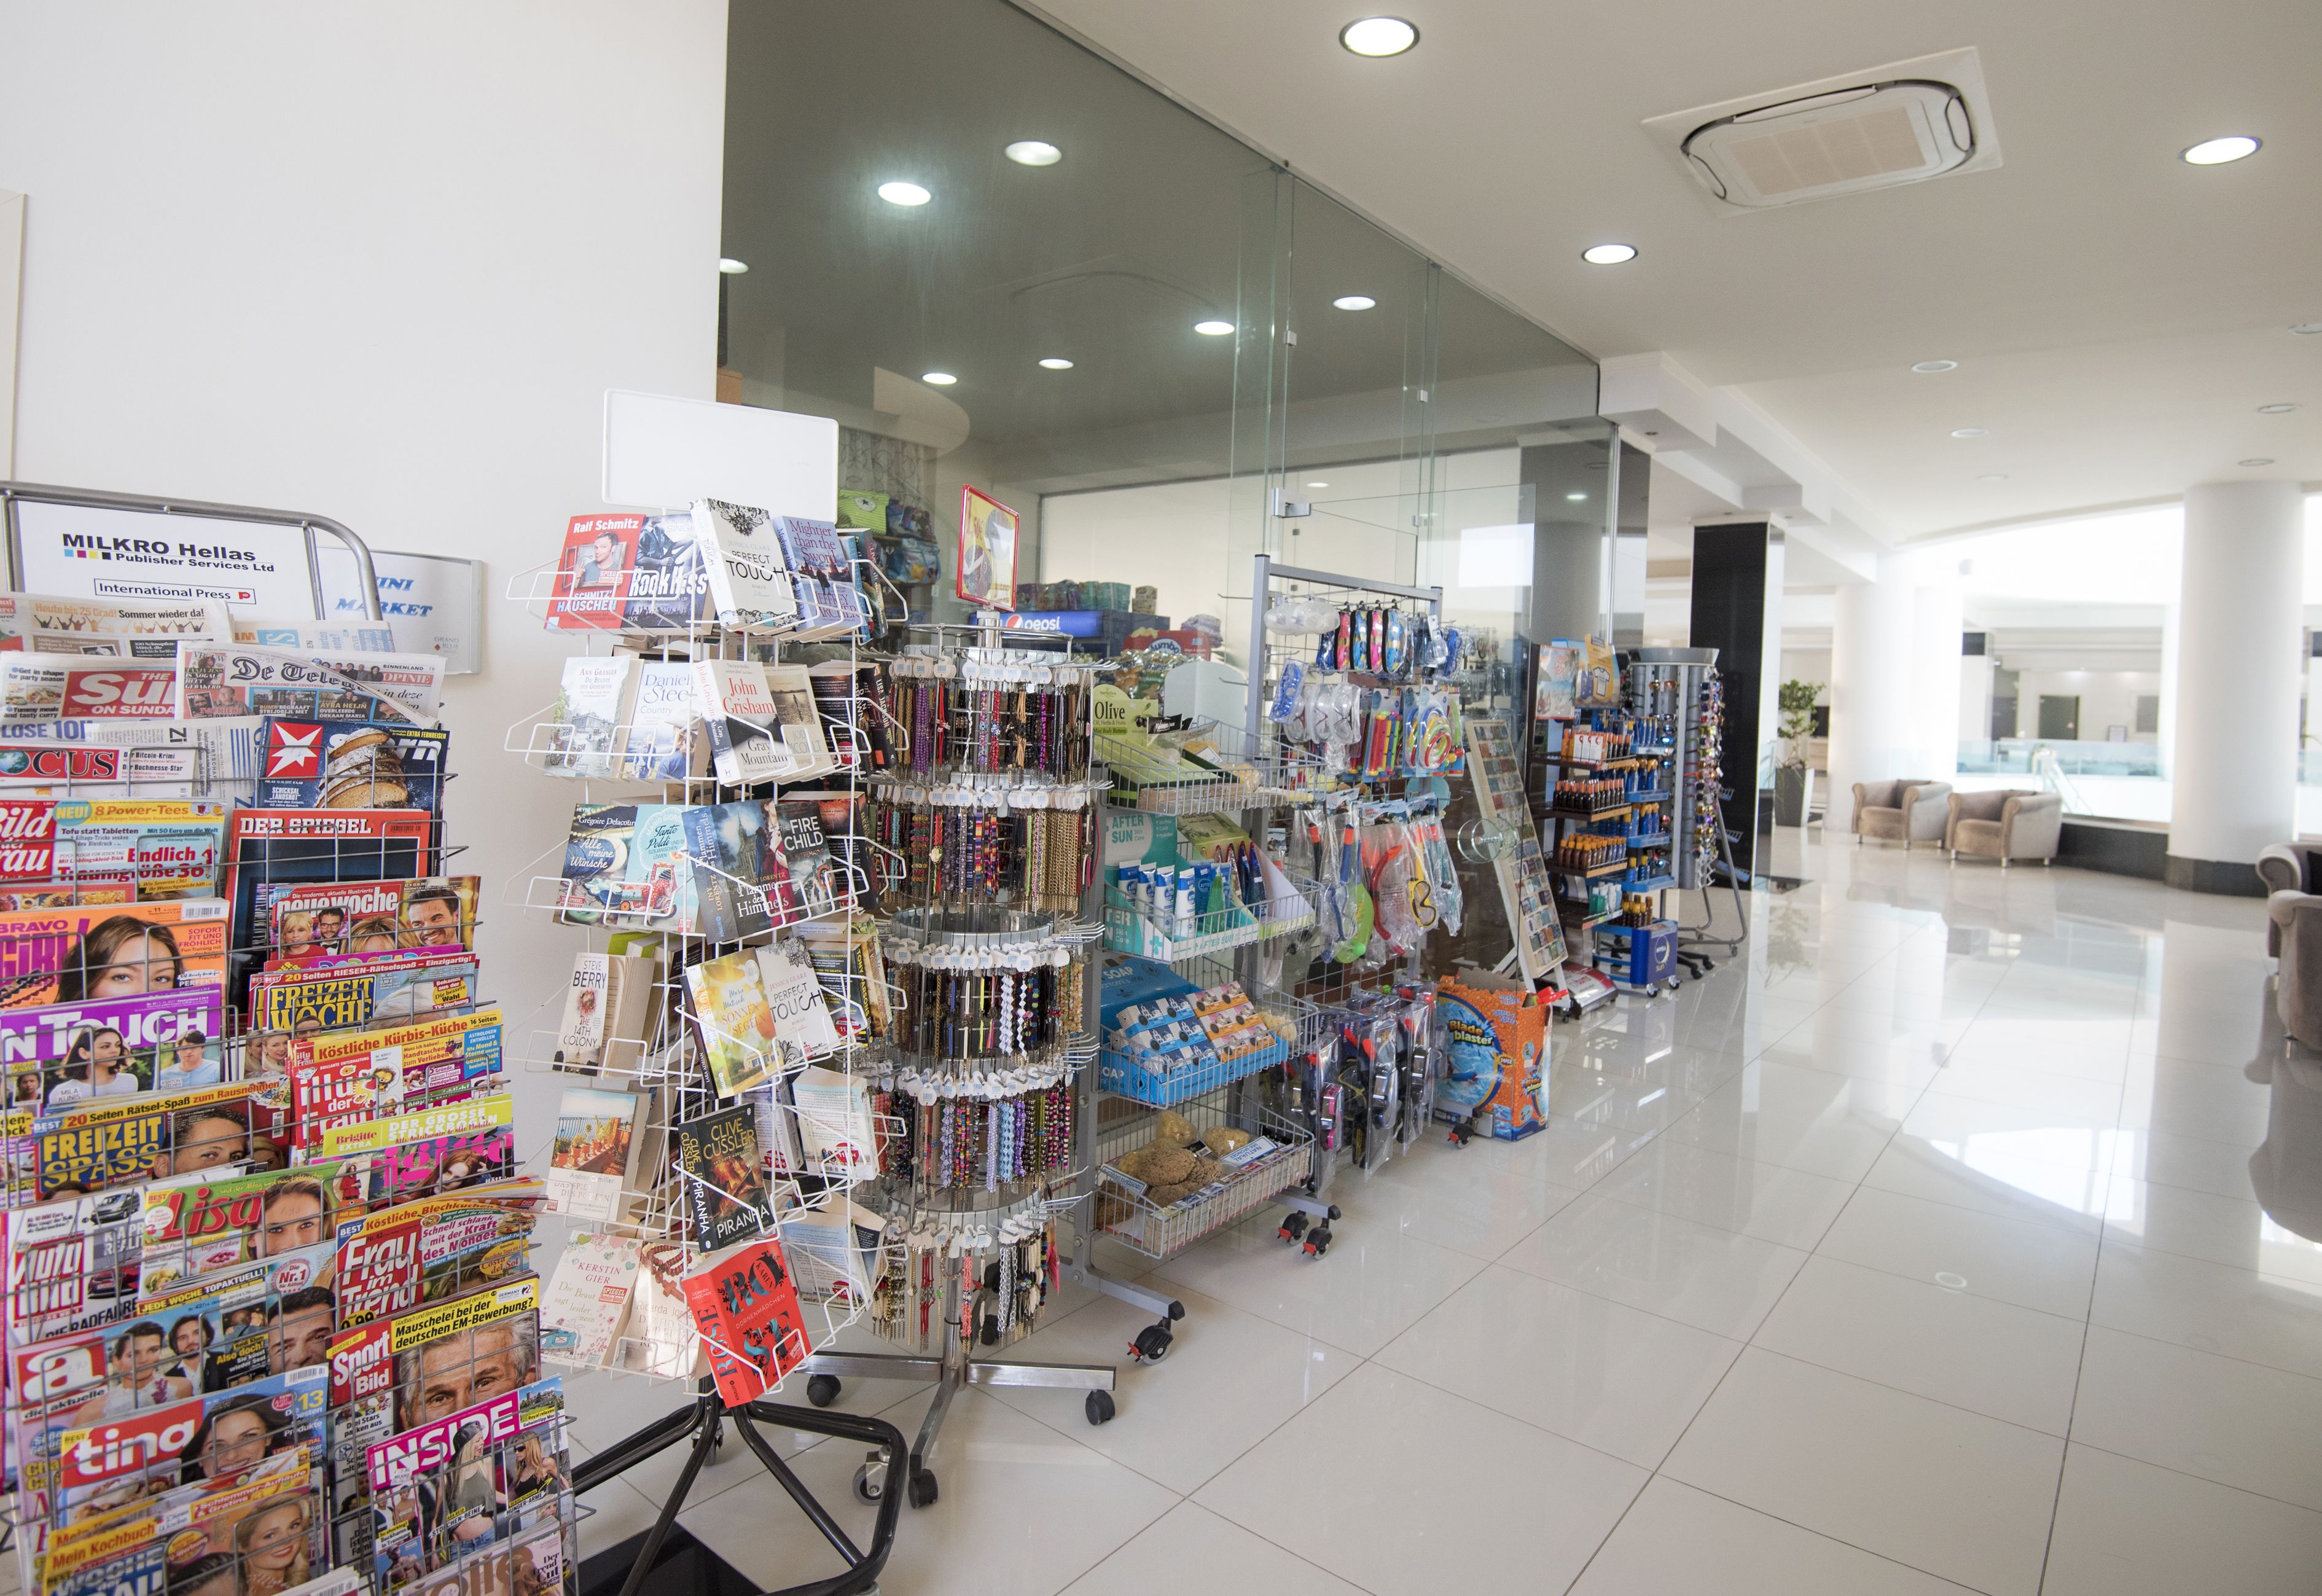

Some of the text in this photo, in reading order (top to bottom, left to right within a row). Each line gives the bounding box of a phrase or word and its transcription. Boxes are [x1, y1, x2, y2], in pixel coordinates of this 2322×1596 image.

[573, 518, 639, 533] Ralf Schmitz
[789, 519, 831, 537] Mightier
[63, 533, 256, 561] MILKRO Hellas
[794, 537, 836, 550] than the
[116, 554, 274, 572] Publisher Services Ltd
[732, 550, 770, 565] PERFECT
[800, 547, 837, 564] Sword
[100, 583, 230, 600] International Press
[119, 608, 204, 619] Sommer wieder da!
[1023, 616, 1061, 630] pepsi
[230, 657, 275, 681] De
[383, 673, 431, 684] OPINIE
[71, 673, 175, 705] Su
[727, 678, 757, 697] John
[640, 706, 673, 715] Country
[723, 698, 775, 714] Grisham
[1095, 702, 1125, 720] Olive
[1, 723, 46, 738] LOSE
[55, 805, 89, 818] NEU!
[95, 805, 188, 816] 8 Power-Tees
[240, 818, 372, 834] DER SPIEGEL
[579, 816, 605, 826] Grégoire
[789, 816, 820, 835] FIRE
[1112, 815, 1144, 829] AFTER
[654, 824, 680, 837] Tante
[1112, 831, 1133, 844] SUN
[580, 838, 602, 850] Alle
[646, 835, 670, 850] Poldi
[784, 831, 824, 851] CHILD
[588, 849, 614, 858] meine
[570, 856, 608, 869] Wünsche
[189, 926, 222, 935] SOFORT
[178, 938, 221, 948] FRÖHLICH
[285, 973, 302, 982] 20
[302, 971, 332, 981] Seiten
[334, 961, 416, 977] RIESEN-Rätselspaß
[426, 955, 472, 968] Einzigartig!
[584, 961, 602, 971] STEVE
[1103, 966, 1133, 979] SOAP
[573, 971, 606, 989] BERRY
[271, 977, 375, 1011] FREIZEIT
[442, 994, 460, 1003] Wahl
[773, 983, 808, 1001] PERFECT
[770, 990, 824, 1023] TOUCH
[270, 1000, 372, 1031] WOCHE
[579, 1015, 590, 1026] THE
[469, 1029, 496, 1038] ASTROLOGEN
[574, 1025, 591, 1036] 14TH
[1448, 1020, 1482, 1035] Blade
[319, 1022, 467, 1059] Köstliche Kürbis-Küche
[470, 1035, 495, 1043] ENTHÜLLEN
[563, 1035, 598, 1048] COLONY
[1453, 1030, 1493, 1046] blaster
[404, 1046, 445, 1060] Handtaschen
[418, 1052, 449, 1063] Verlieben
[68, 1082, 279, 1127] 20 Seiten Rätsel-Spaß zum Rausnehmen
[34, 1120, 61, 1131] BEST
[710, 1117, 743, 1142] CLIVE
[44, 1116, 163, 1162] FREIZEIT
[337, 1132, 377, 1144] Brigitte
[339, 1140, 372, 1151] EXTRA
[702, 1129, 756, 1160] CUSSLER
[44, 1144, 160, 1189] SPASS
[158, 1186, 265, 1241] Lisa
[366, 1201, 493, 1231] Köstliche Blechkuchen
[692, 1181, 711, 1235] PIRANHA
[423, 1215, 493, 1238] Schnell schlank
[716, 1204, 770, 1239] PIRANHA
[340, 1222, 362, 1238] BEST
[431, 1220, 497, 1246] mit der Kraft
[343, 1232, 418, 1285] Frau
[424, 1248, 445, 1262] des
[577, 1261, 622, 1275] KERSTIN
[367, 1272, 393, 1291] im
[586, 1273, 611, 1285] GIER
[140, 1269, 265, 1315] JEDE WOCHE TOPAKTUELL!
[395, 1301, 491, 1339] Mauschelei bei der
[396, 1297, 534, 1349] deutschen EM-Bewerbung?
[334, 1331, 390, 1388] Sport
[355, 1368, 389, 1396] Bild
[50, 1388, 105, 1414] aktuelle
[74, 1420, 195, 1476] tina
[53, 1524, 156, 1568] Mein Kochbuch
